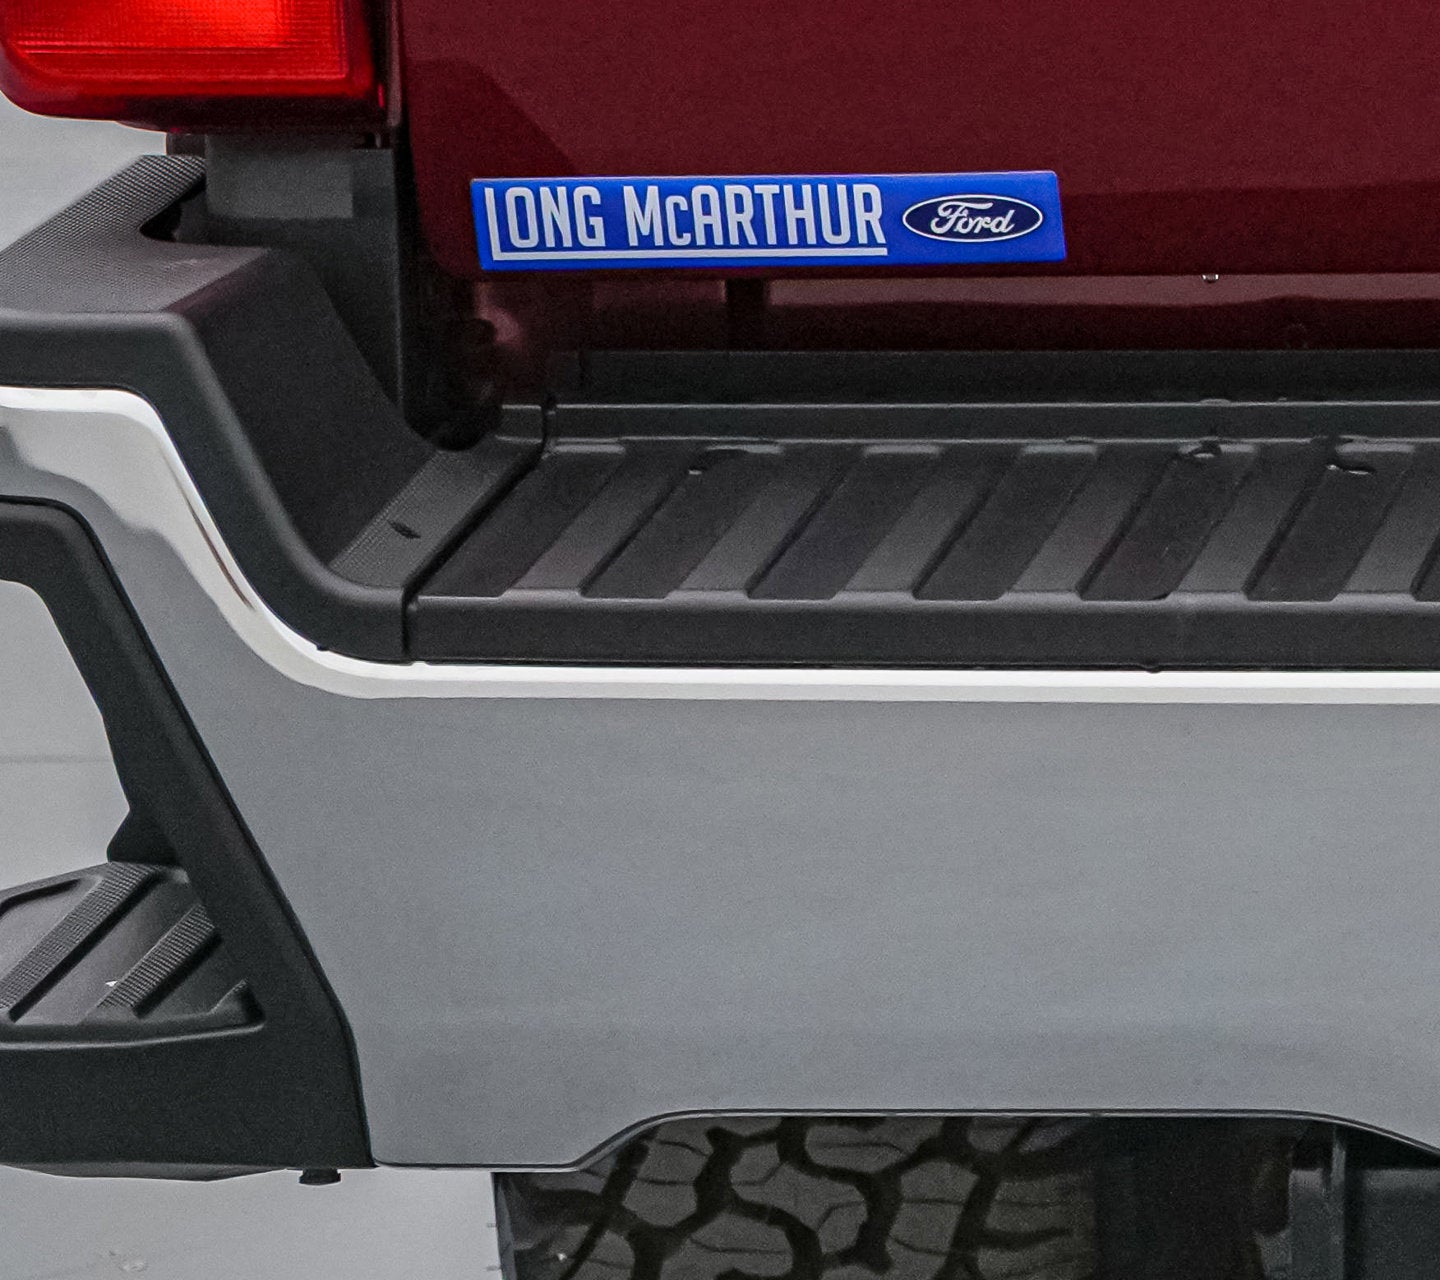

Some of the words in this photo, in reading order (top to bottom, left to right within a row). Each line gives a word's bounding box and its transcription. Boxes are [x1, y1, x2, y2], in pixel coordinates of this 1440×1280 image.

[484, 184, 605, 260] LONG
[624, 183, 886, 247] McARTHUR
[929, 201, 1015, 236] Ford
